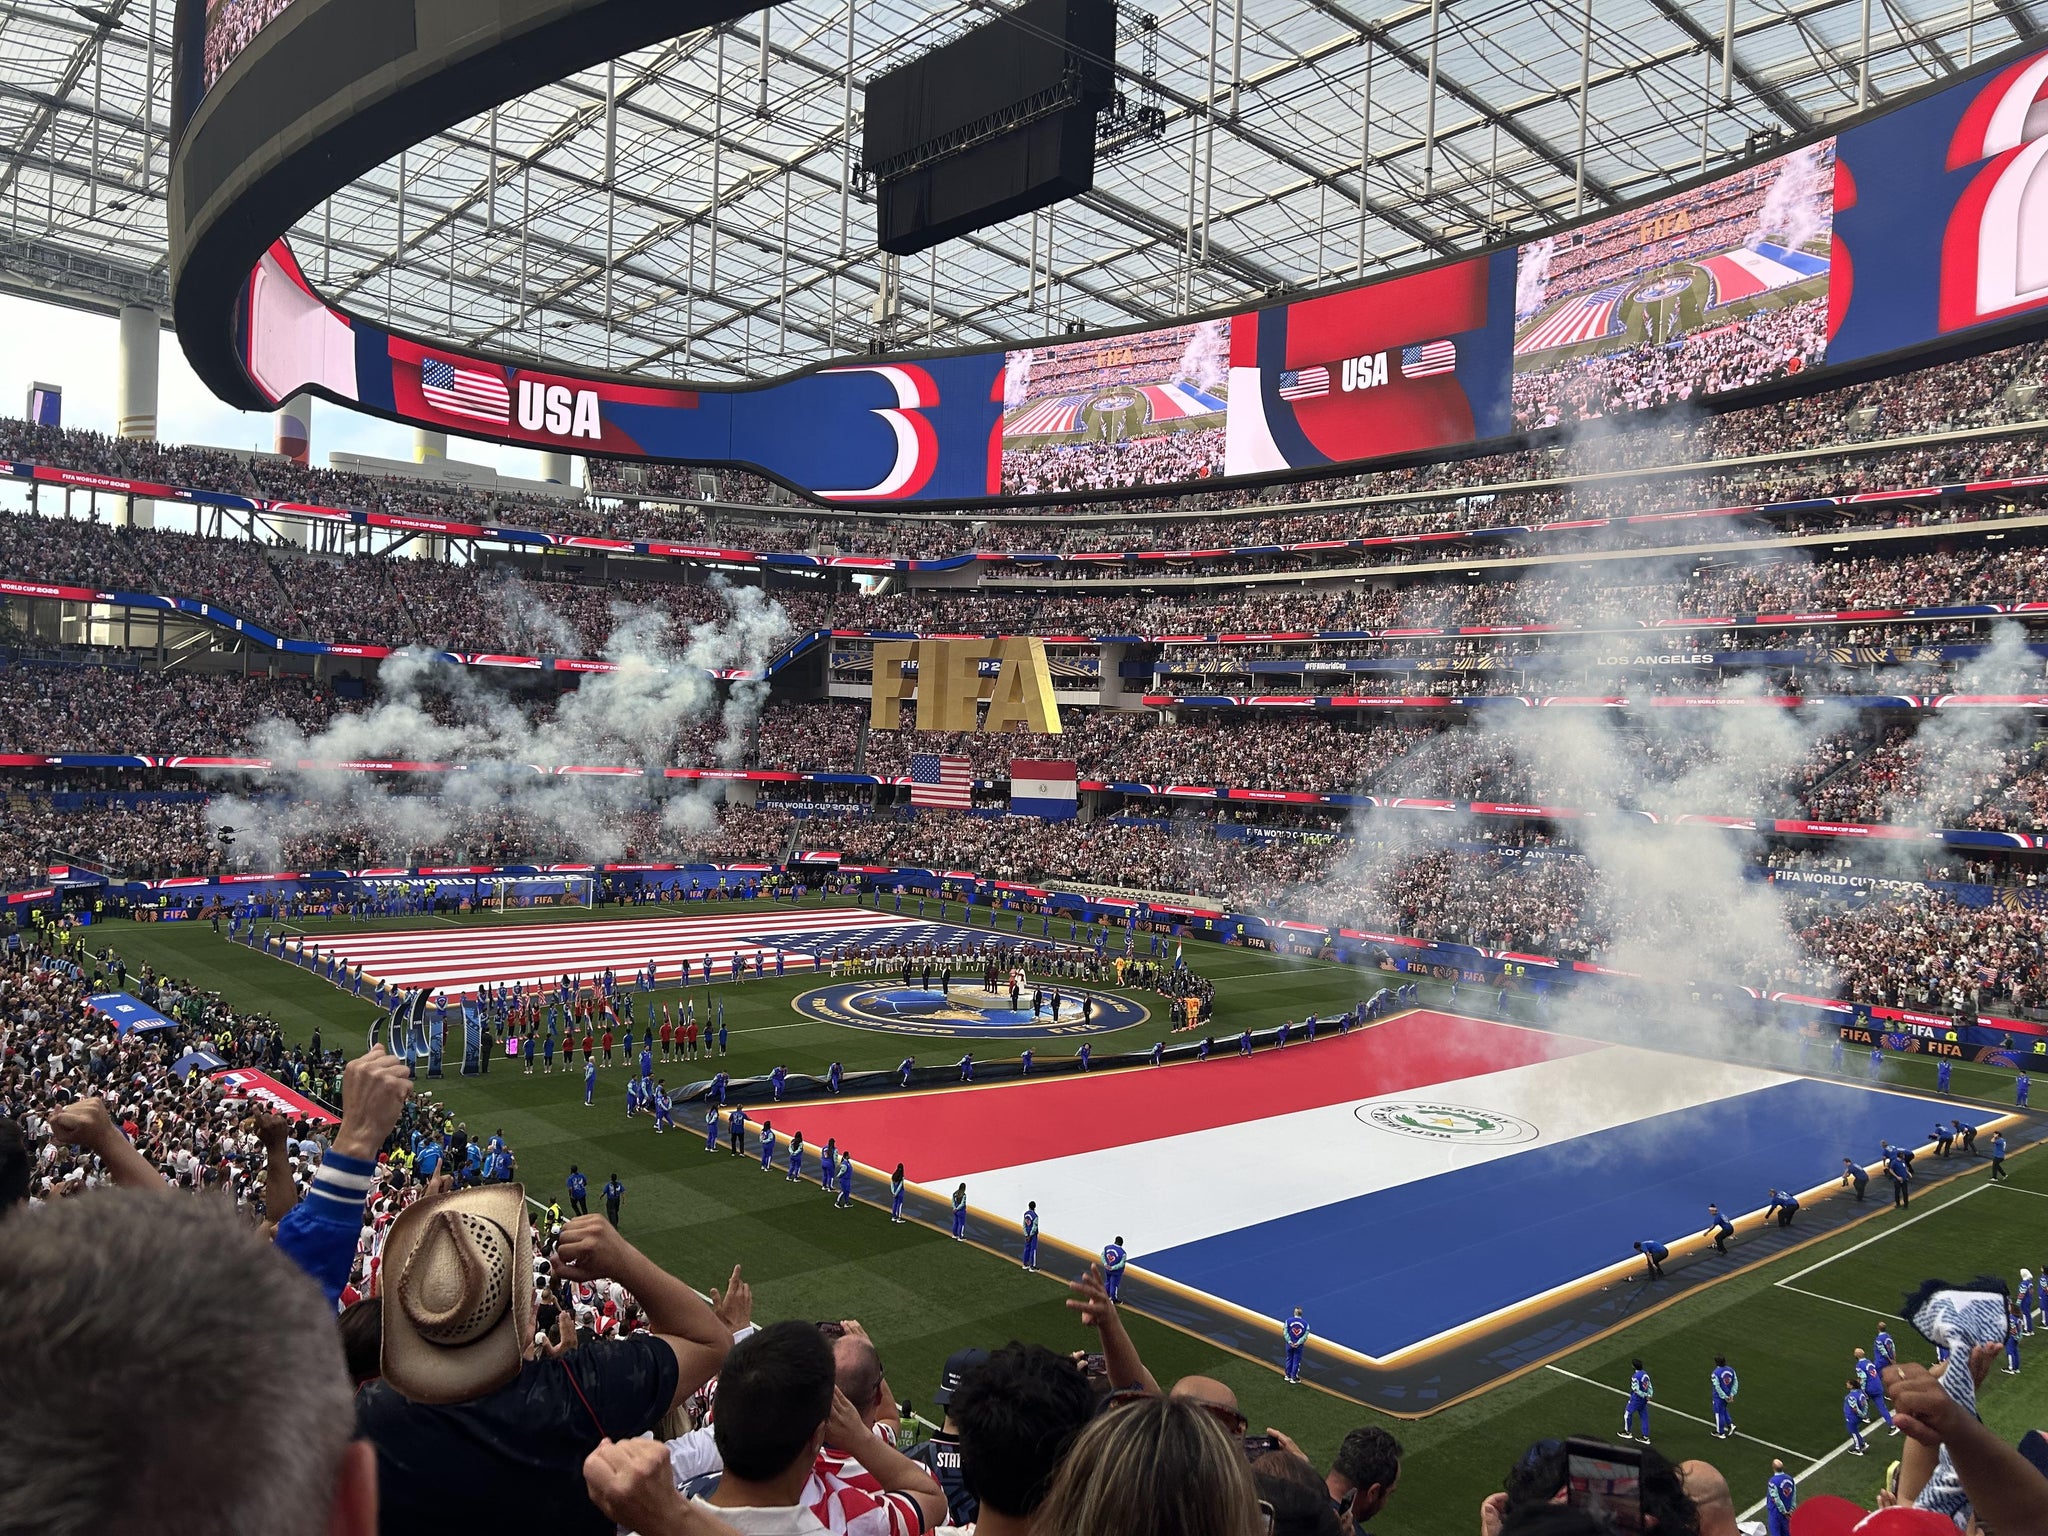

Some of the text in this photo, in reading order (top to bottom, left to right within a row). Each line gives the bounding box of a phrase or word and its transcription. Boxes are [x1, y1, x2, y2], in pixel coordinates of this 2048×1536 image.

[1640, 208, 1692, 244] FIFA
[1341, 351, 1389, 393] USA
[517, 379, 602, 440] USA
[75, 475, 97, 484] WORLD
[1, 583, 23, 591] WORLD
[1597, 654, 1714, 666] LOS ANGELES
[1304, 661, 1347, 671] #FIFAWorldCup
[870, 636, 1063, 734] FIFA
[767, 801, 784, 809] FIFA
[785, 802, 813, 810] WORLD
[815, 803, 831, 811] CUP
[1498, 848, 1521, 857] LOS
[362, 879, 402, 888] FIFA
[406, 877, 477, 886] WORLD
[1775, 870, 1801, 881] FIFA
[1803, 872, 1848, 886] WORLD
[646, 892, 656, 900] FA
[690, 890, 703, 898] IFA
[912, 887, 924, 895] FIFA
[482, 897, 501, 907] FIFA
[534, 895, 553, 905] FIFA
[304, 904, 326, 914] FIFA
[1007, 901, 1020, 910] FIFA
[1039, 906, 1053, 915] FIFA
[163, 910, 189, 920] FIFA
[1155, 923, 1171, 933] FIFA
[1248, 938, 1265, 948] FIFA
[1294, 945, 1312, 956] FIFA
[1407, 962, 1428, 974] FIFA
[1463, 971, 1485, 983] FIFA
[1914, 1015, 1934, 1024] WORLD
[1840, 1027, 1872, 1043] FIFA
[1928, 1041, 1962, 1057] FIFA
[1415, 1103, 1514, 1125] PARAGUAY
